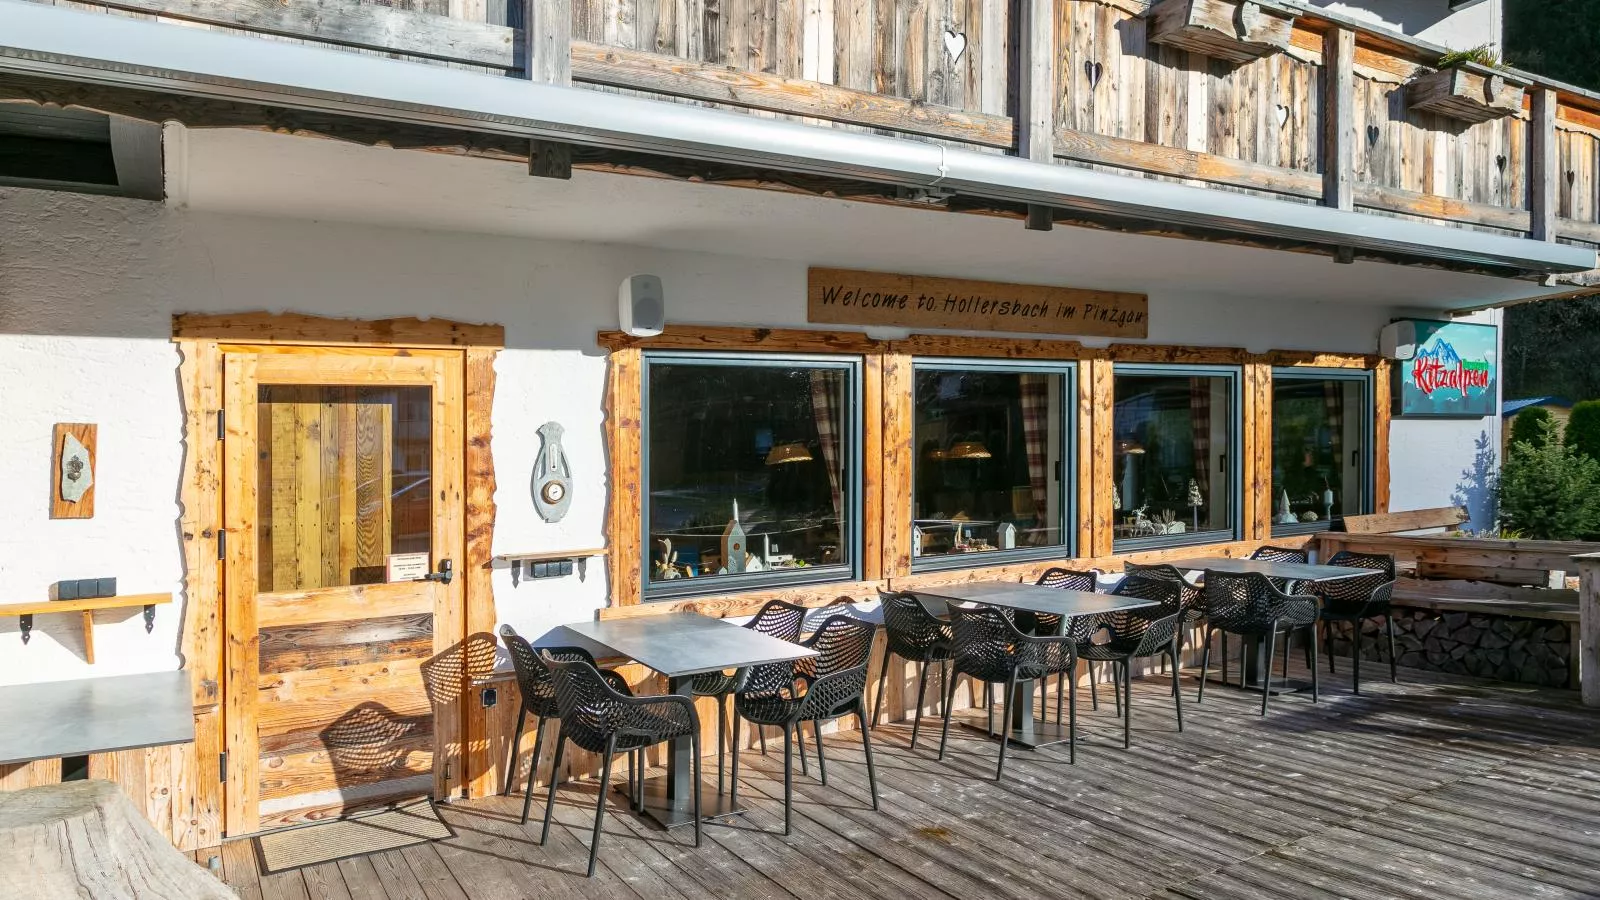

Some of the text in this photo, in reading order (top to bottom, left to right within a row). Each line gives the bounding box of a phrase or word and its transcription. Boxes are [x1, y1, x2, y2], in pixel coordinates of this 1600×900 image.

[822, 286, 909, 310] Welcome
[943, 294, 1048, 319] Hollersbach
[1056, 302, 1075, 319] im
[1083, 303, 1144, 328] Pinzgau
[1412, 356, 1489, 397] Kitzalpen
